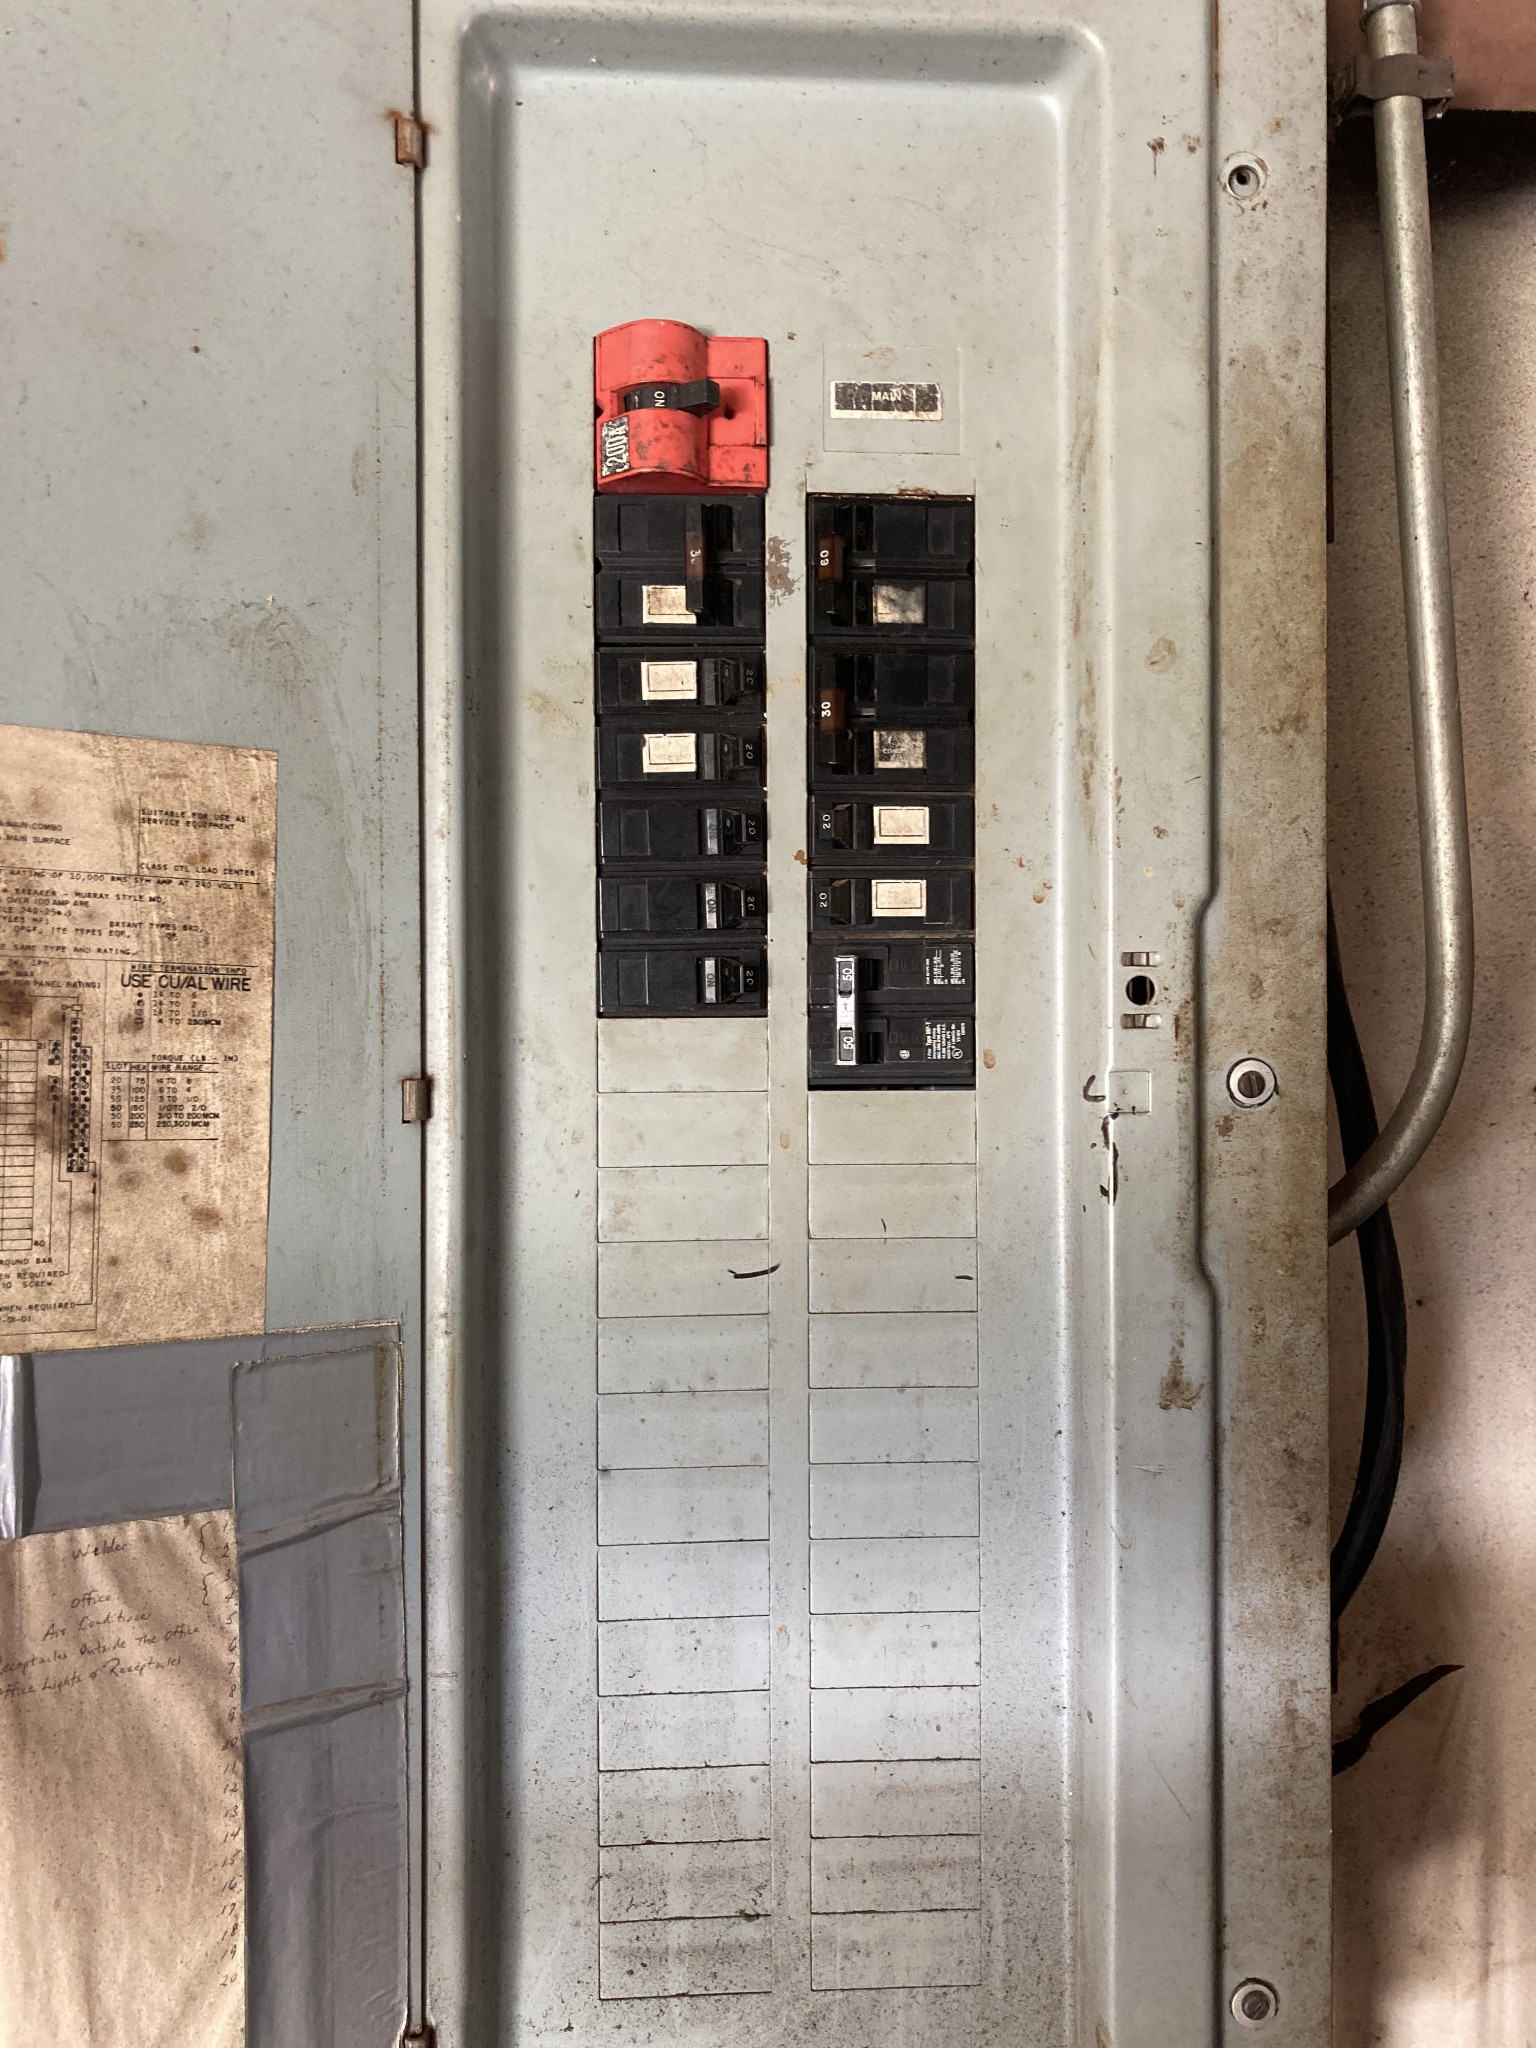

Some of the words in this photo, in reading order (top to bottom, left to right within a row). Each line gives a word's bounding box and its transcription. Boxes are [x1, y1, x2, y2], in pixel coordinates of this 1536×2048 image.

[654, 390, 665, 407] ON
[871, 390, 902, 401] MAIN
[821, 701, 831, 718] 30
[745, 743, 754, 760] 20
[141, 808, 186, 818] SUITABLE
[191, 812, 208, 820] FOR
[141, 817, 180, 827] SERVICE
[186, 820, 236, 830] EQUIPMENT
[748, 819, 756, 835] 20
[822, 814, 831, 830] 20
[32, 836, 71, 845] SURFACE
[140, 863, 168, 871] CLASS
[196, 866, 219, 874] LOAD
[223, 868, 256, 876] CENTER
[70, 872, 105, 882] 10,000
[15, 888, 58, 897] BREAKER
[74, 891, 110, 900] MURRAY
[115, 894, 145, 902] STYLE
[819, 892, 827, 908] 20
[74, 928, 103, 937] TYPES
[149, 922, 177, 931] TYPES
[43, 945, 67, 953] TYPE
[73, 946, 92, 954] AND
[131, 964, 153, 972] WIRE
[159, 965, 220, 974] TERMINATION
[225, 967, 248, 975] INFO
[842, 967, 854, 981] 50
[121, 974, 153, 989] USE
[158, 974, 209, 991] CU/AL
[211, 977, 252, 992] WIRE
[843, 1036, 854, 1050] 50
[151, 1054, 184, 1063] TORQUE
[104, 1062, 127, 1070] SLOT
[175, 1064, 204, 1072] RANGE
[165, 1077, 177, 1085] TO
[166, 1095, 178, 1103] TO
[110, 1112, 122, 1120] 50
[129, 1112, 146, 1120] 200
[173, 1112, 185, 1120] TO
[129, 1120, 145, 1128] 250
[191, 1120, 210, 1128] MCM
[33, 1239, 46, 1247] 40
[35, 1256, 53, 1264] BAR
[16, 1270, 65, 1280] REQUIRED
[22, 1280, 53, 1289] SCREW
[28, 1301, 76, 1312] REQUIRED
[71, 1536, 127, 1560] Welder
[222, 1542, 230, 1558] 2
[225, 1589, 235, 1603] 4
[225, 1611, 238, 1625] 5
[228, 1636, 237, 1652] 6
[228, 1661, 236, 1675] 7
[228, 1683, 237, 1698] 8
[223, 1760, 237, 1775] 11
[223, 1782, 239, 1794] 12
[224, 1804, 239, 1818] 13
[223, 1826, 241, 1843] 14
[222, 1849, 243, 1868] 15
[221, 1876, 238, 1893] 16
[221, 1902, 237, 1916] 17
[221, 1922, 239, 1941] 18
[220, 1944, 237, 1961] 19
[220, 1974, 238, 1987] 20
